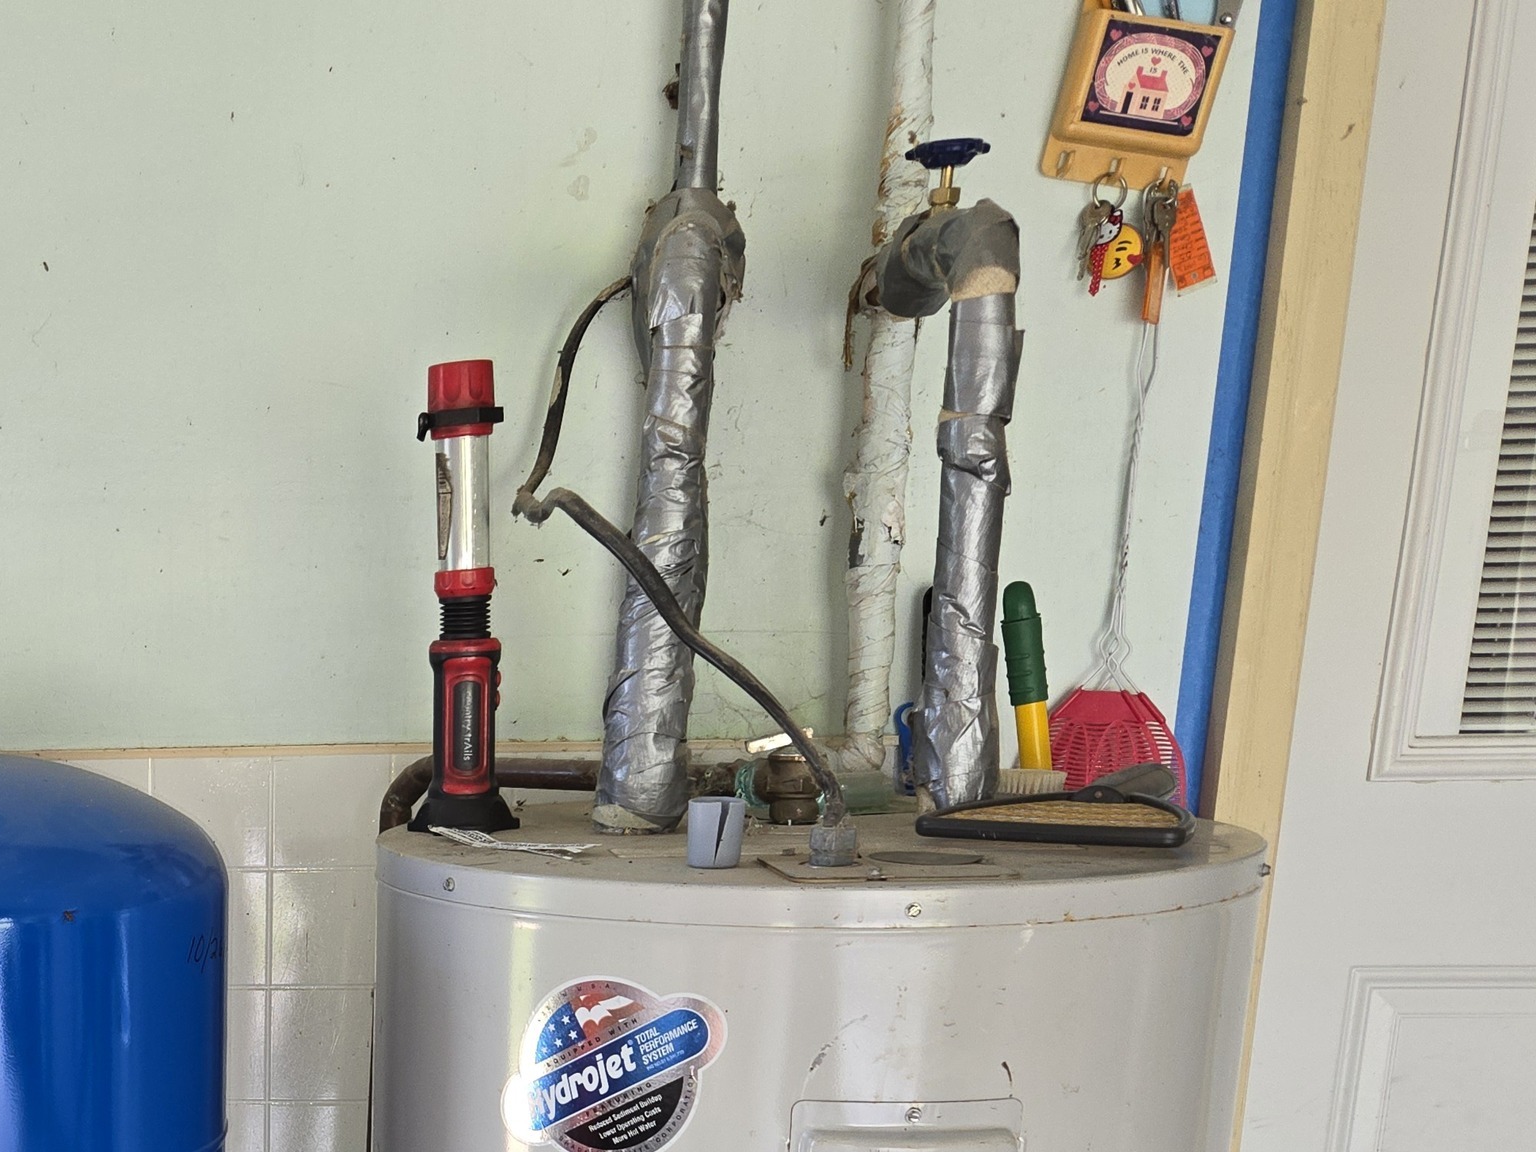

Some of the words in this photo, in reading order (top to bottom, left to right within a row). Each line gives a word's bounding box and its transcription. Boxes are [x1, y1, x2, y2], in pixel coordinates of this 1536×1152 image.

[1117, 51, 1139, 66] HOME
[1151, 48, 1176, 61] WHERE
[1178, 60, 1189, 74] THE
[609, 1018, 637, 1036] WITH
[634, 1027, 660, 1045] TOTAL
[639, 1019, 698, 1055] PERFORMANCE
[642, 1043, 675, 1065] SYSTEM
[588, 1117, 613, 1132] Reduced
[613, 1105, 640, 1121] Sediment
[639, 1094, 662, 1109] Buildup
[599, 1127, 617, 1139] Lower
[617, 1115, 645, 1131] Operating
[645, 1106, 662, 1118] Costs
[612, 1133, 629, 1144] More
[628, 1128, 639, 1137] Hot
[640, 1120, 657, 1132] Water
